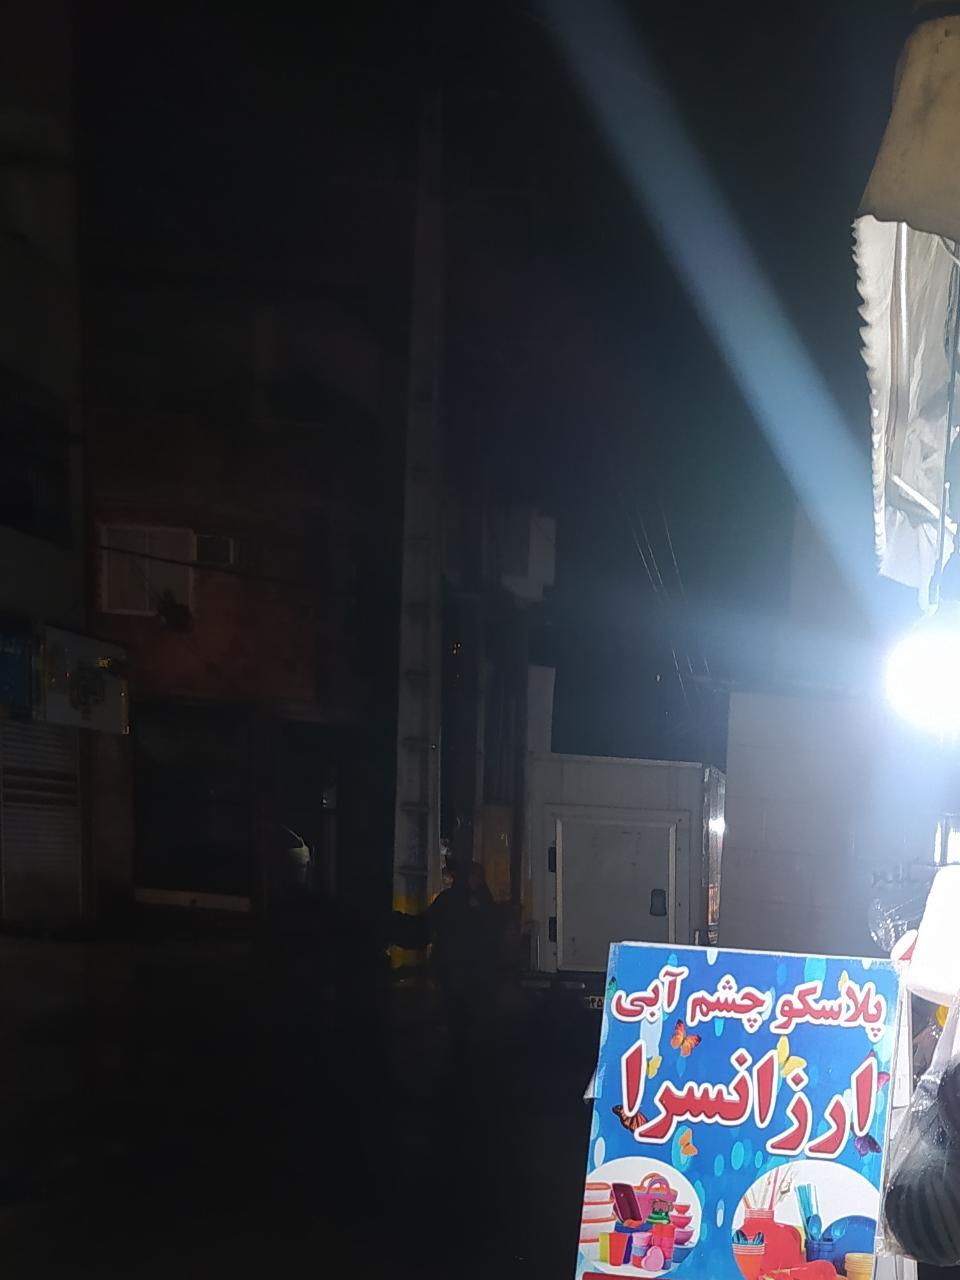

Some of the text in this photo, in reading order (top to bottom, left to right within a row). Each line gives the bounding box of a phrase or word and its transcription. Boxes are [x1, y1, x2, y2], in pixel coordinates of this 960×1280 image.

[612, 965, 886, 1041] پلاسکو چشم آبی
[621, 1040, 878, 1158] ارزانسرا
